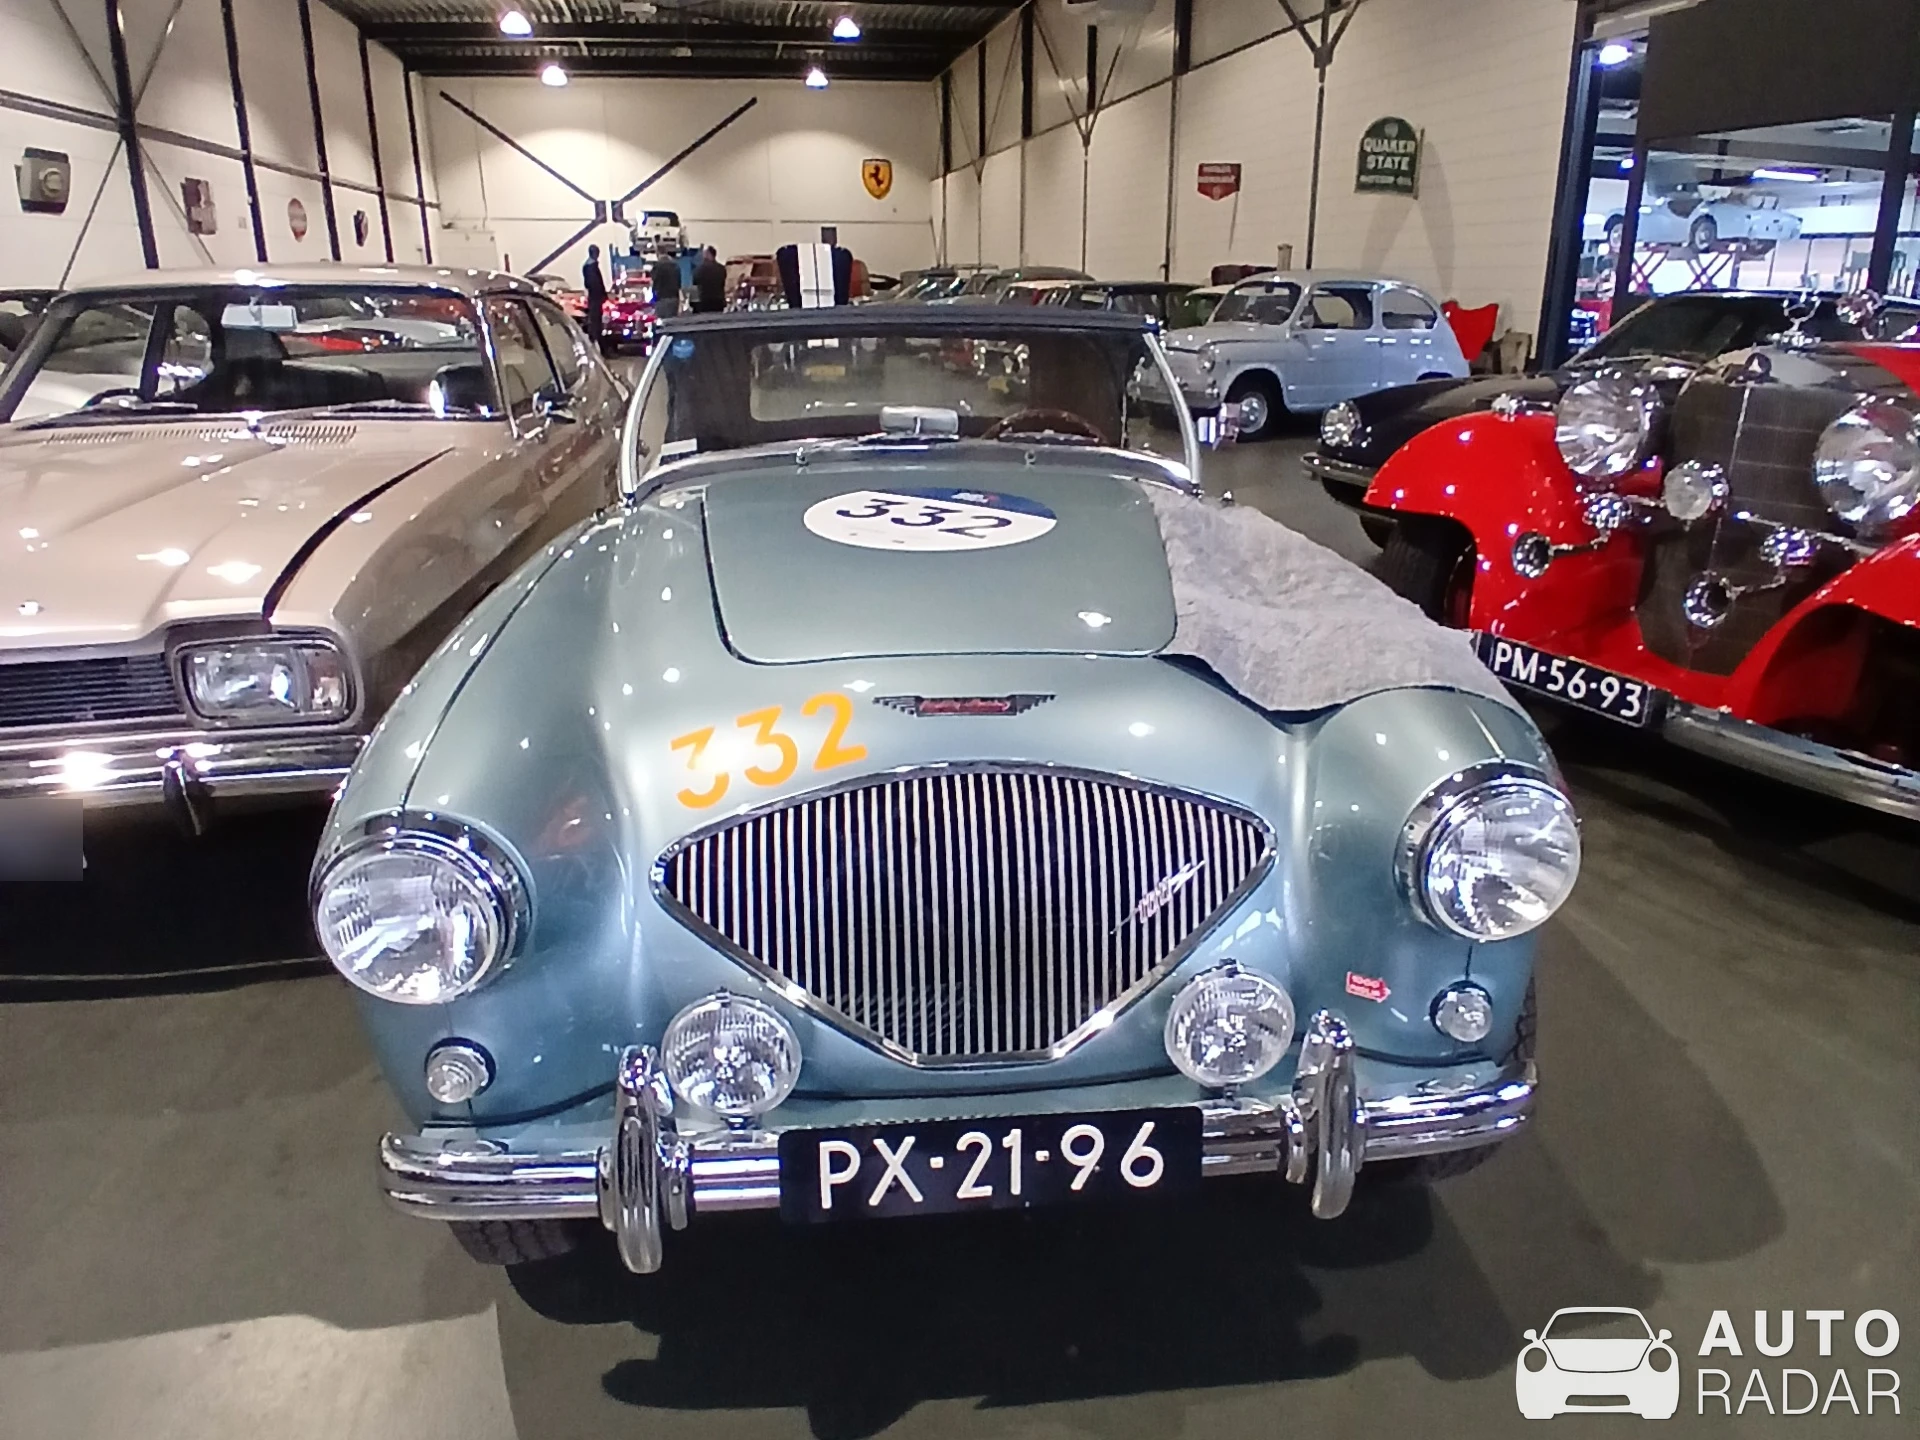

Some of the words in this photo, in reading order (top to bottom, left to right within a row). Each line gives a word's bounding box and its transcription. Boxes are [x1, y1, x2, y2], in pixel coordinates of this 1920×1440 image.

[1363, 137, 1416, 153] QUAKER
[1366, 154, 1410, 170] STATE
[836, 498, 1013, 539] 332
[670, 691, 869, 810] 332
